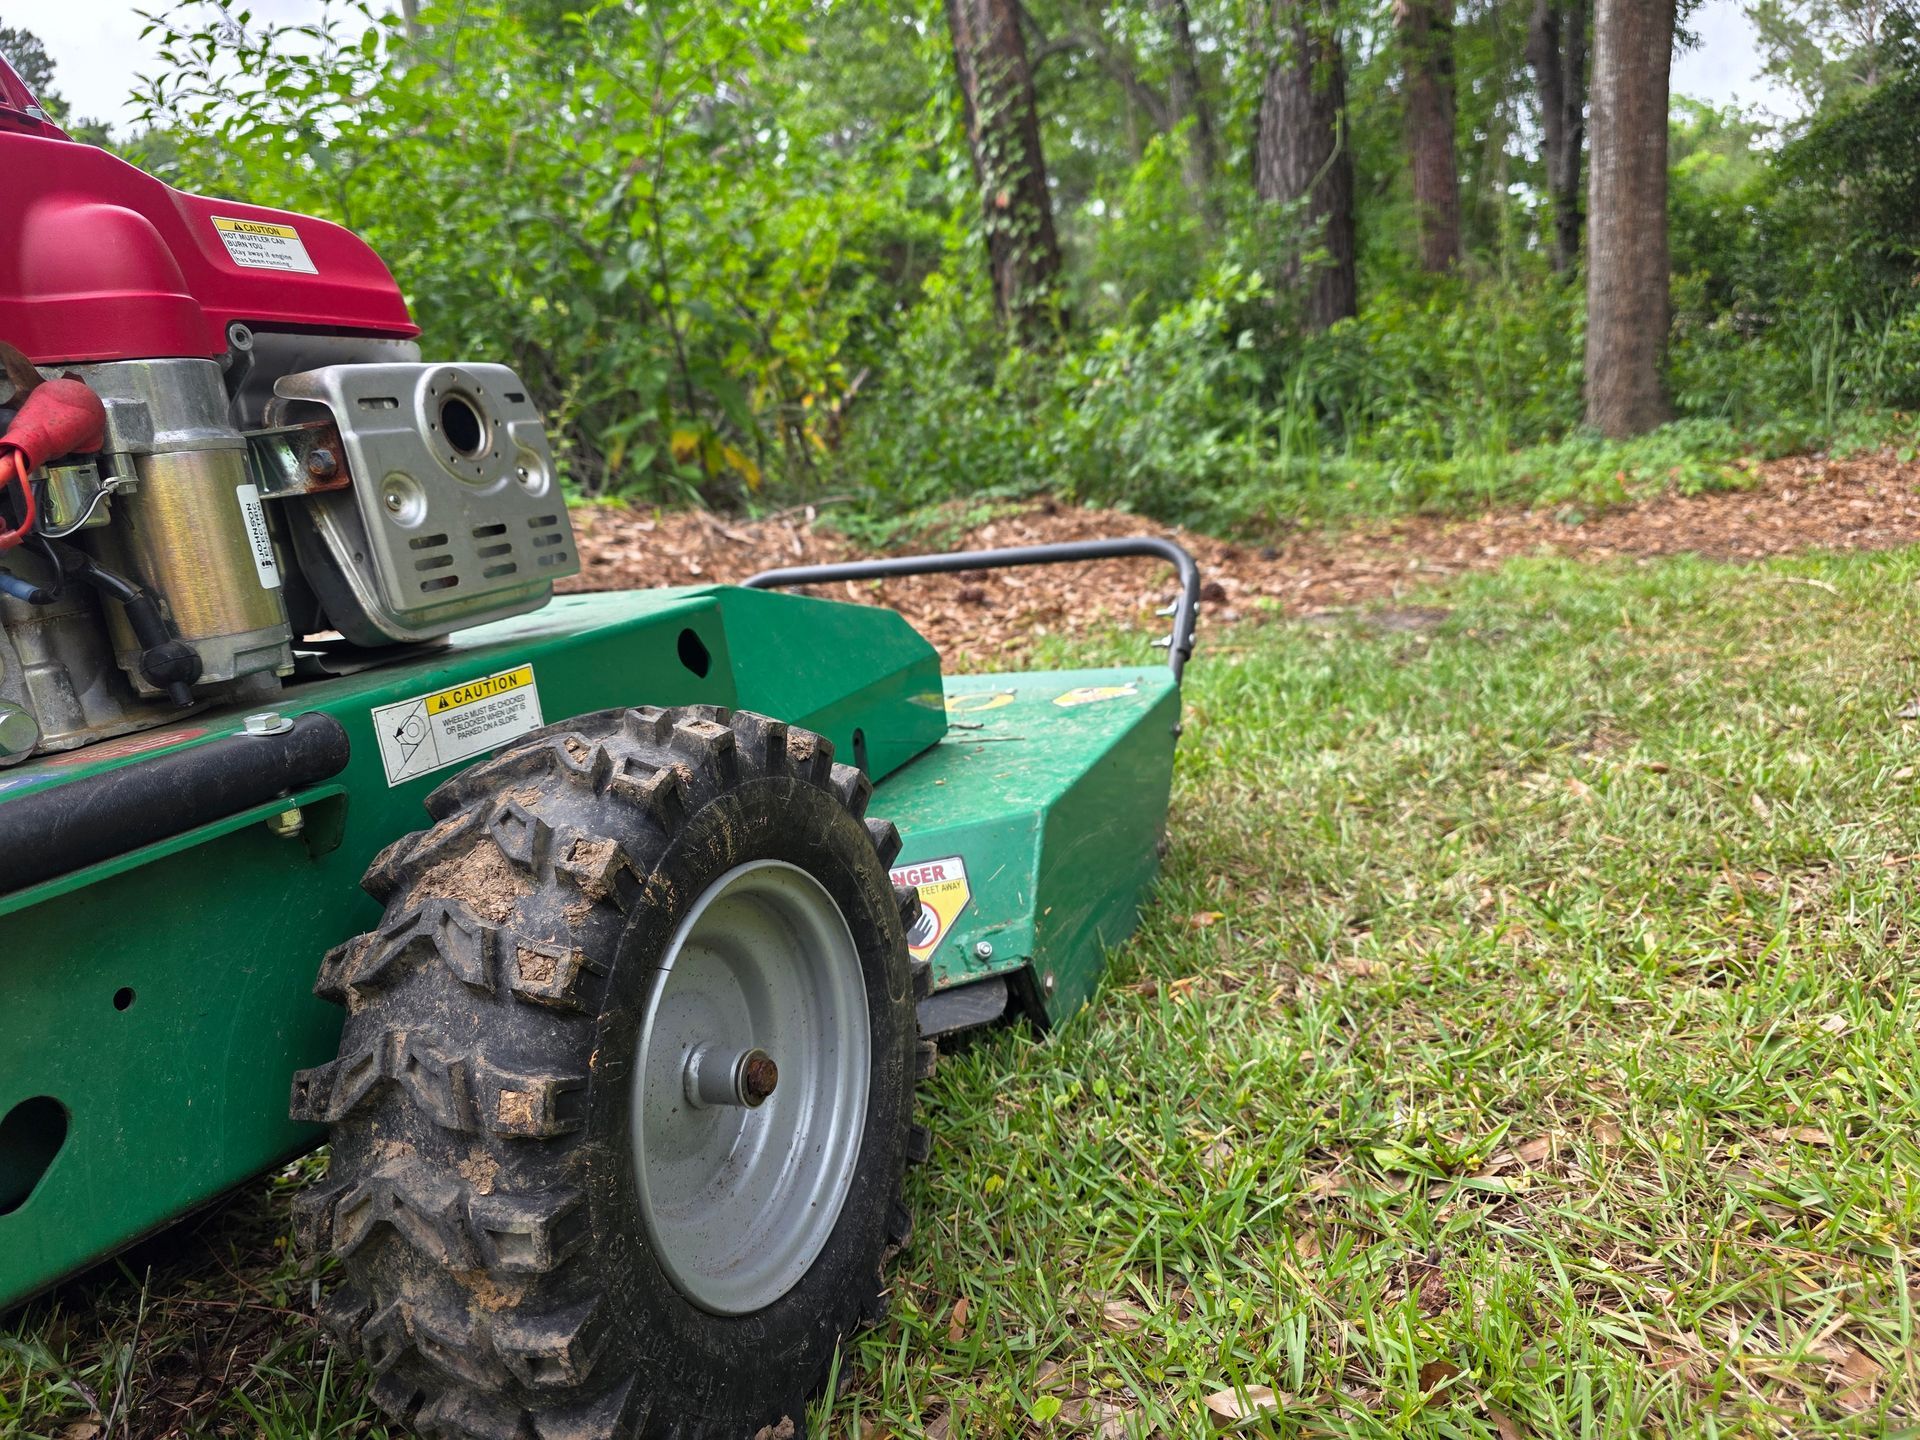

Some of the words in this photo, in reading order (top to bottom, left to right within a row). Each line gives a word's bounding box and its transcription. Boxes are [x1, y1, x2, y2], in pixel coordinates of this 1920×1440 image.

[239, 233, 270, 243] MUFFLER
[271, 237, 285, 245] CAN
[243, 224, 280, 235] CAUTION
[227, 240, 248, 248] BURN
[249, 242, 265, 250] YOU.
[230, 248, 246, 256] Stay
[248, 250, 264, 258] away
[271, 253, 293, 261] engine
[246, 503, 265, 559] JOHNSON
[252, 502, 269, 557] ELECTRIC
[453, 673, 518, 704] CAUTION
[442, 711, 470, 727] WHEELS
[469, 705, 487, 718] MUST
[488, 703, 496, 712] BE
[497, 694, 526, 709] CHOCKED
[446, 725, 457, 735] OR
[457, 715, 487, 733] BLOCKED
[487, 710, 506, 724] WHEN
[506, 704, 519, 715] UNIT
[519, 702, 526, 711] IS
[457, 725, 483, 740] PARKED
[483, 721, 493, 732] ON
[493, 720, 500, 729] A
[892, 865, 946, 887] NGER
[921, 885, 940, 896] FEET
[941, 881, 961, 892] AWAY
